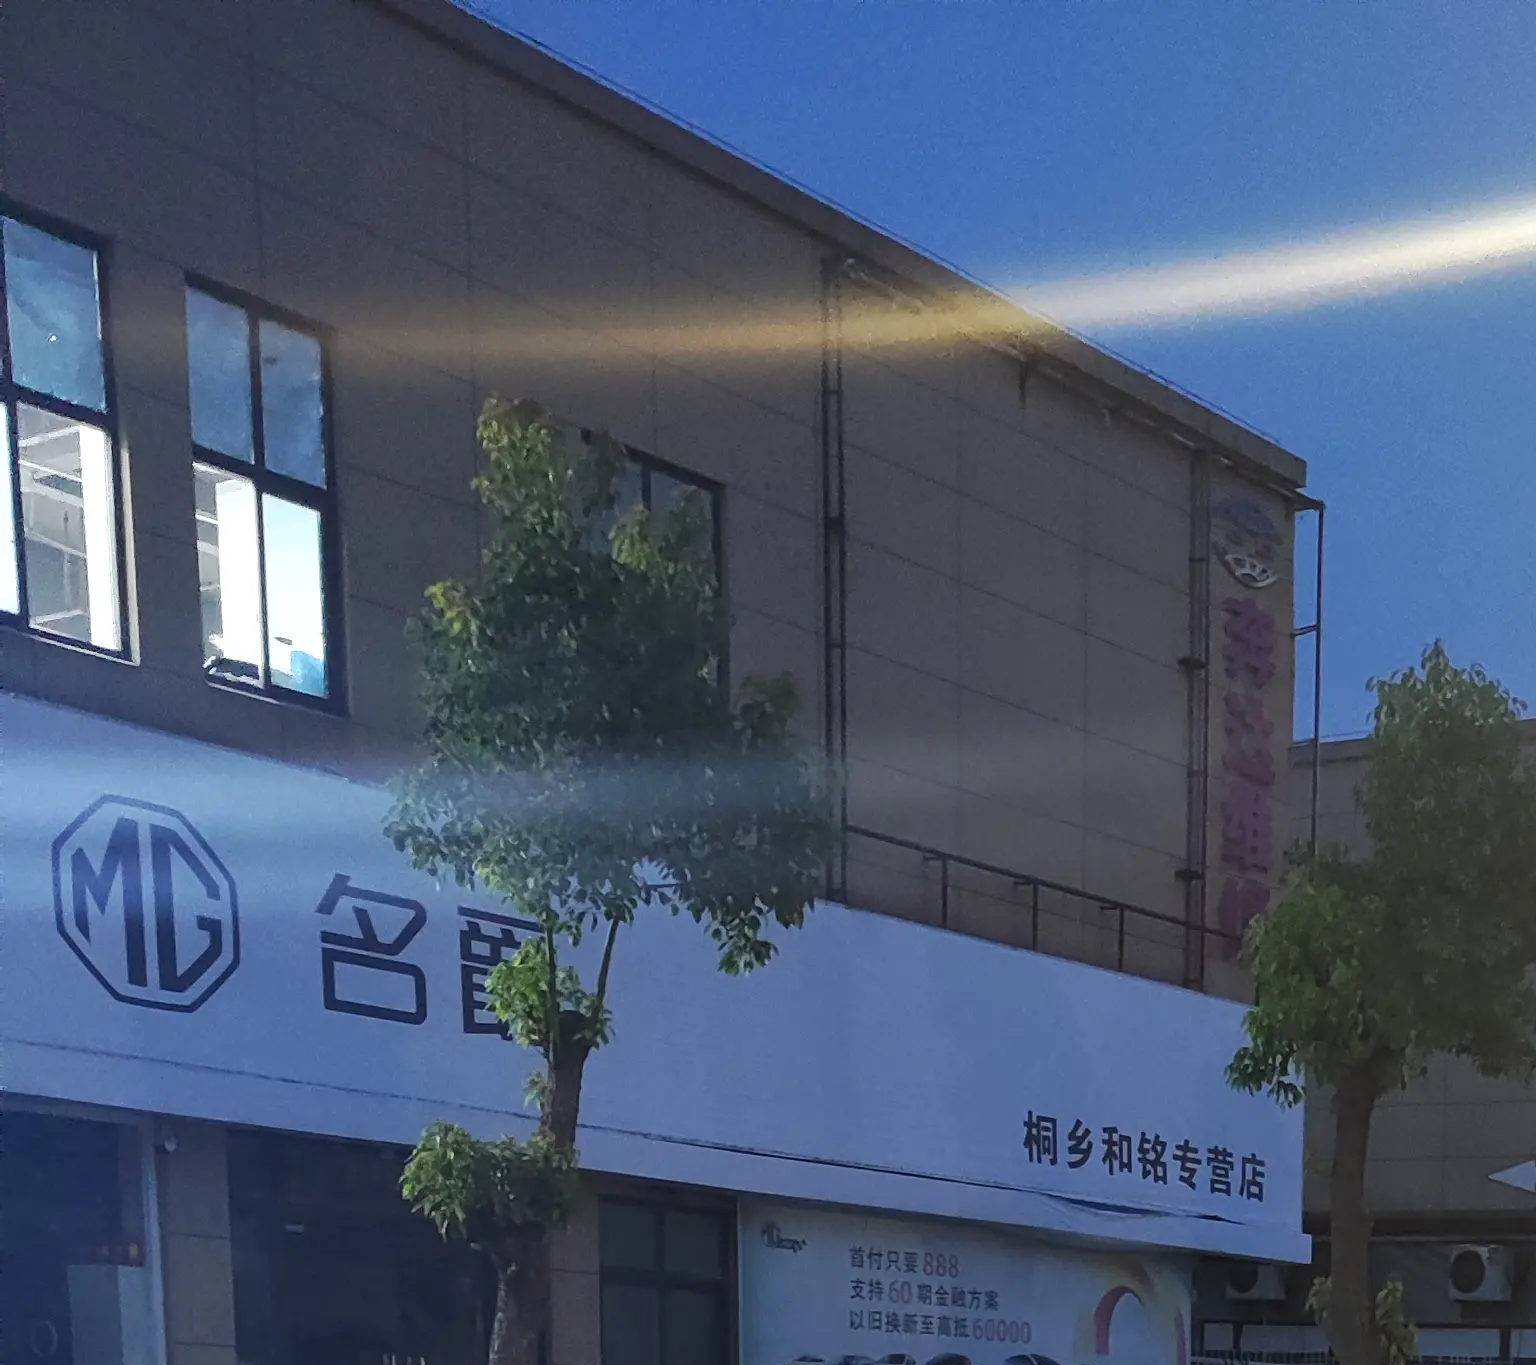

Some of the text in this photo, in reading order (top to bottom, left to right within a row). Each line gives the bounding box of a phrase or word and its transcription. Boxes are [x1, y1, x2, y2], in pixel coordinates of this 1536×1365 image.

[70, 815, 223, 994] MG
[1022, 1110, 1266, 1203] 桐乡和铭专营店
